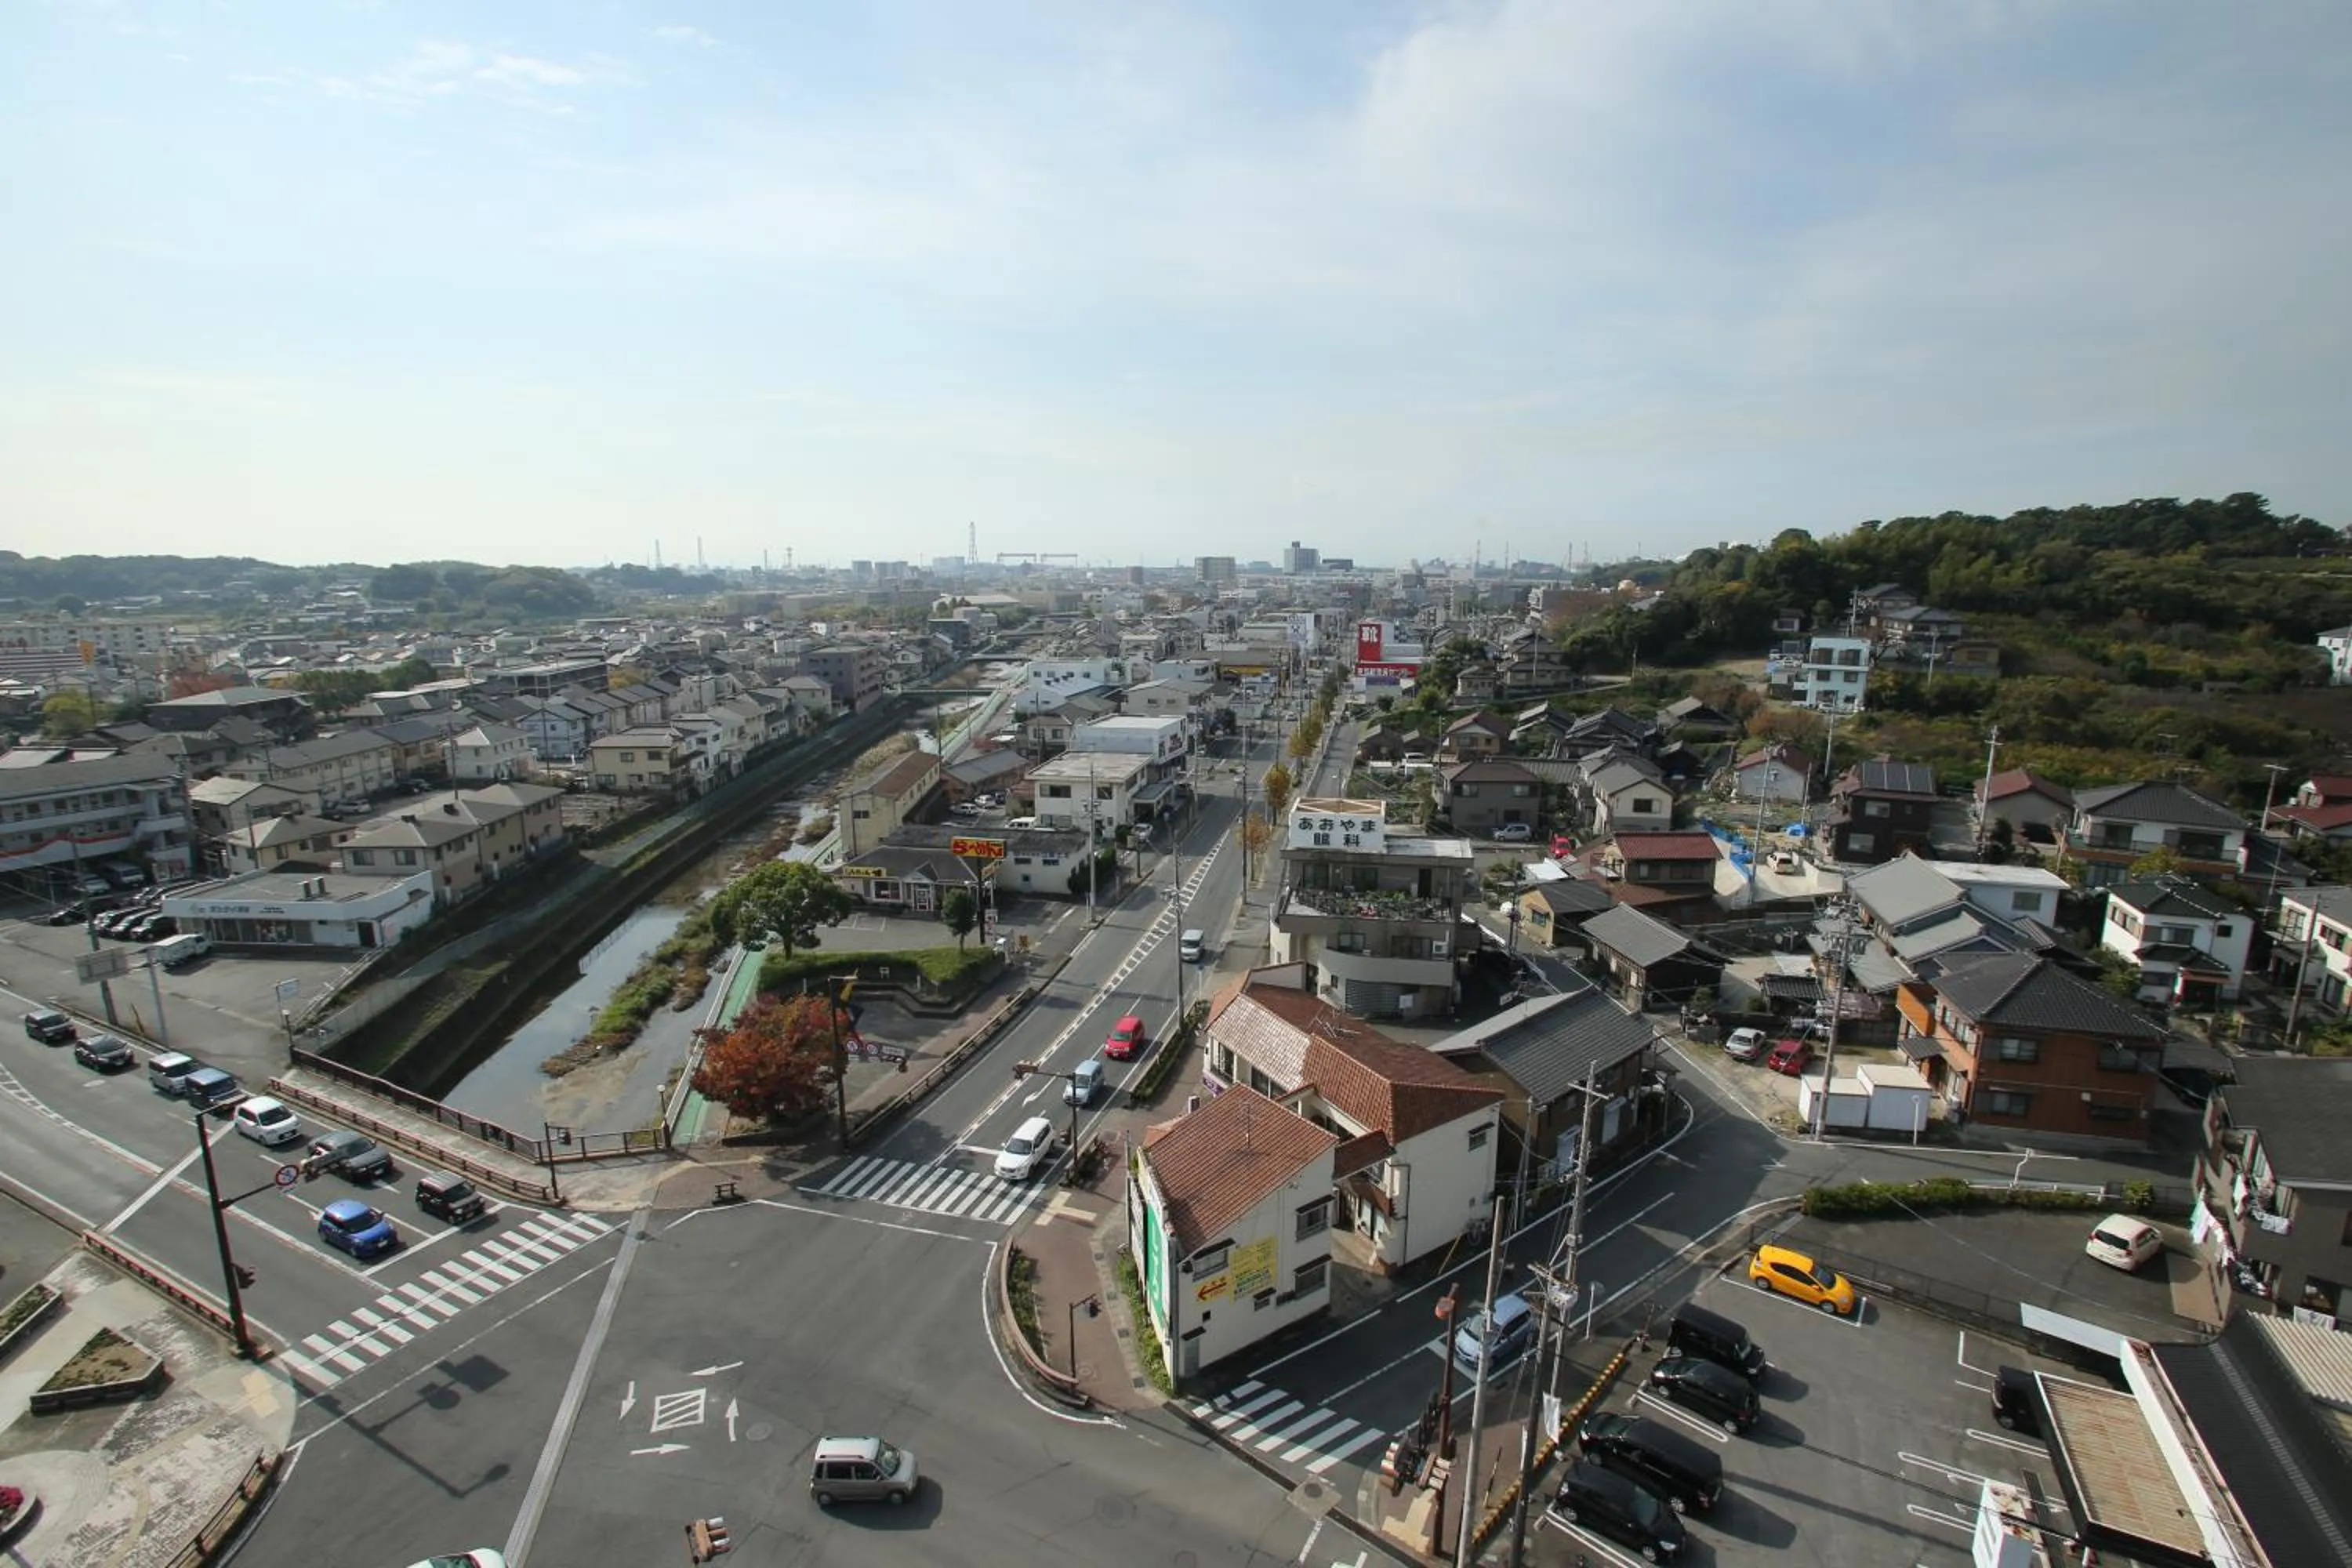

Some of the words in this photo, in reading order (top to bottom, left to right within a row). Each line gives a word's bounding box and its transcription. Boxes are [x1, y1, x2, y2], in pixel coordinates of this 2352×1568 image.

[1298, 817, 1377, 832] あおやま
[1313, 832, 1360, 847] 眼科
